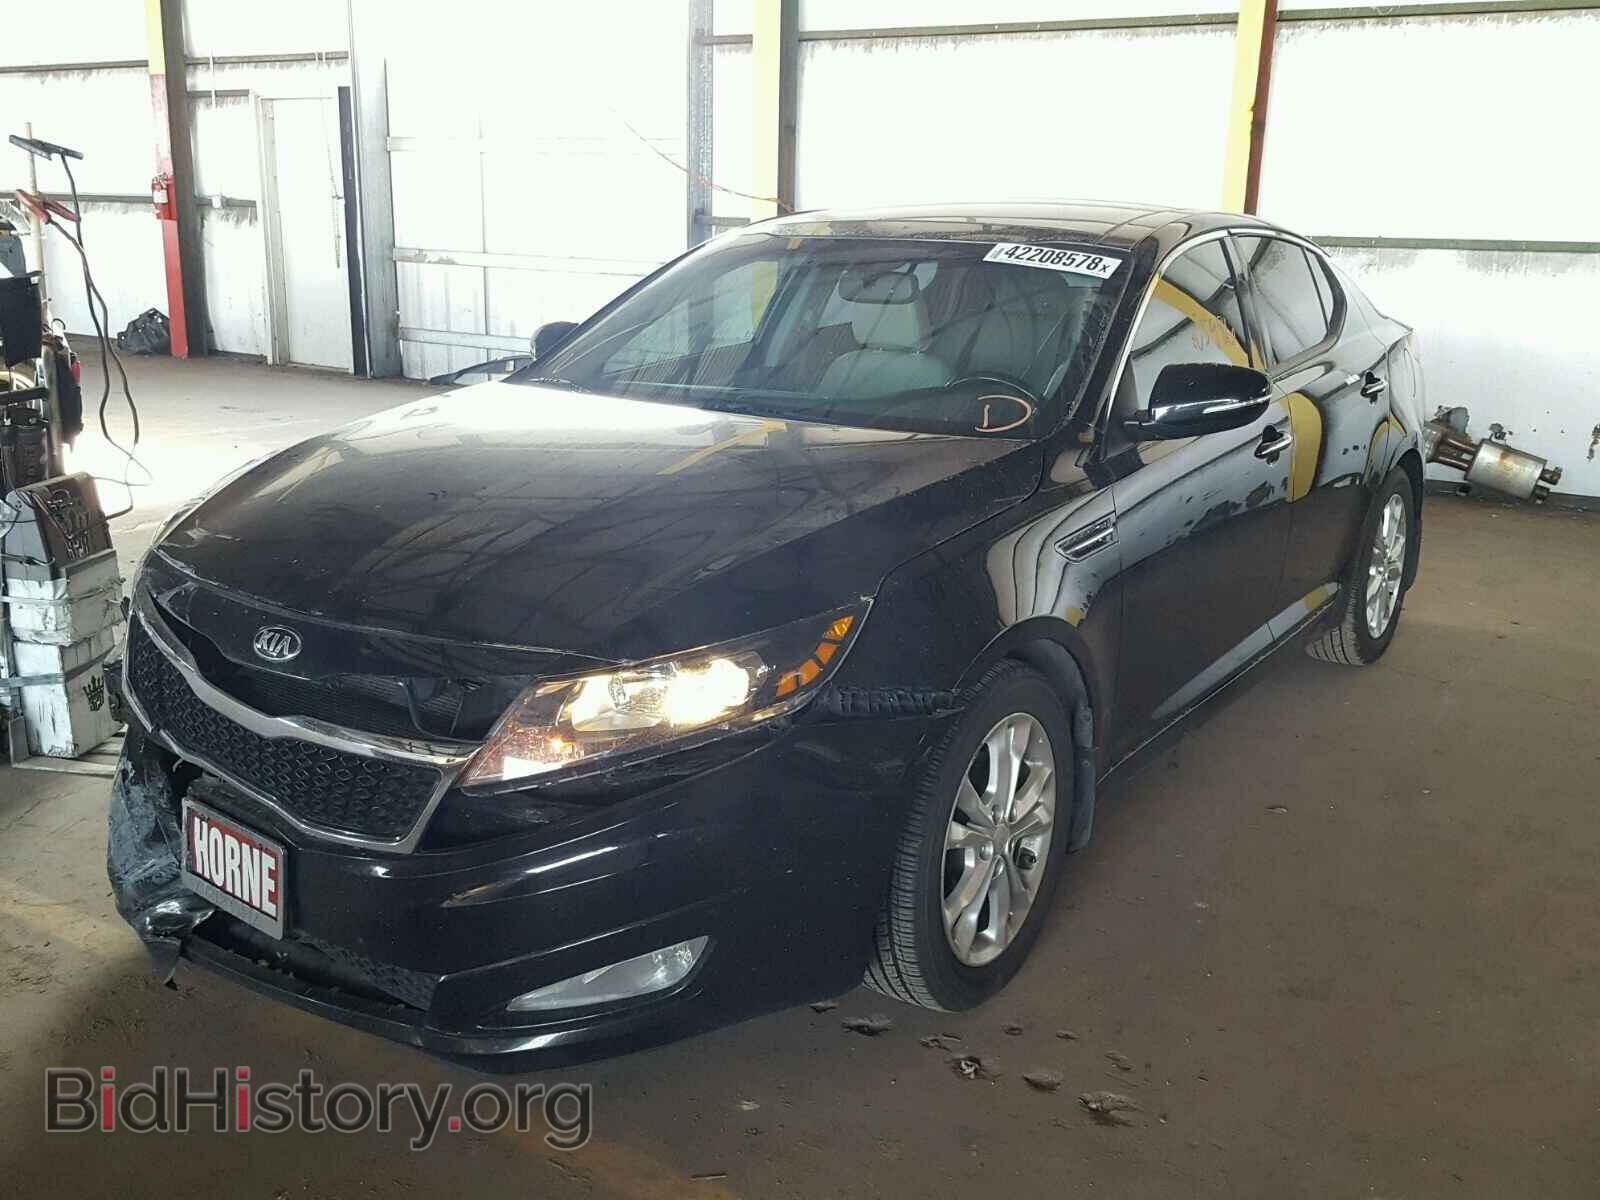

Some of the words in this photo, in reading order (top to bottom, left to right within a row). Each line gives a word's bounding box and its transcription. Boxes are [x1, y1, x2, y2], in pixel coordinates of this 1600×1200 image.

[975, 394, 1032, 432] D
[255, 630, 292, 656] KIA
[193, 815, 277, 918] HORNE
